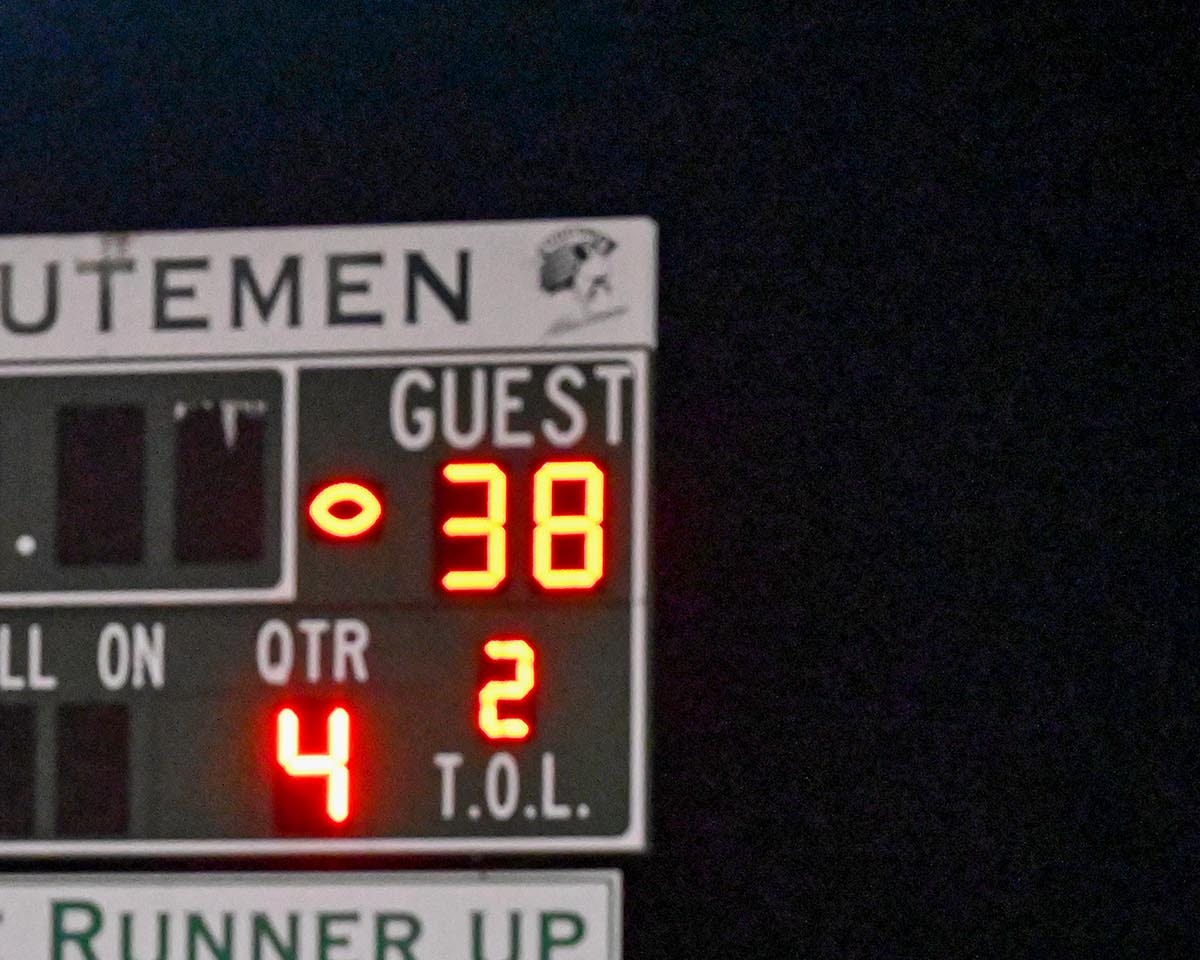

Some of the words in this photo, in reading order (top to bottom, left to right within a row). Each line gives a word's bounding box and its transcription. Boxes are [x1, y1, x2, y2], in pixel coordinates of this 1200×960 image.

[389, 362, 632, 450] GUEST
[440, 460, 605, 591] 38
[96, 620, 165, 689] ON
[255, 618, 371, 685] QTR
[477, 638, 536, 740] 2
[274, 705, 352, 824] 4
[433, 752, 591, 820] T.O.L.
